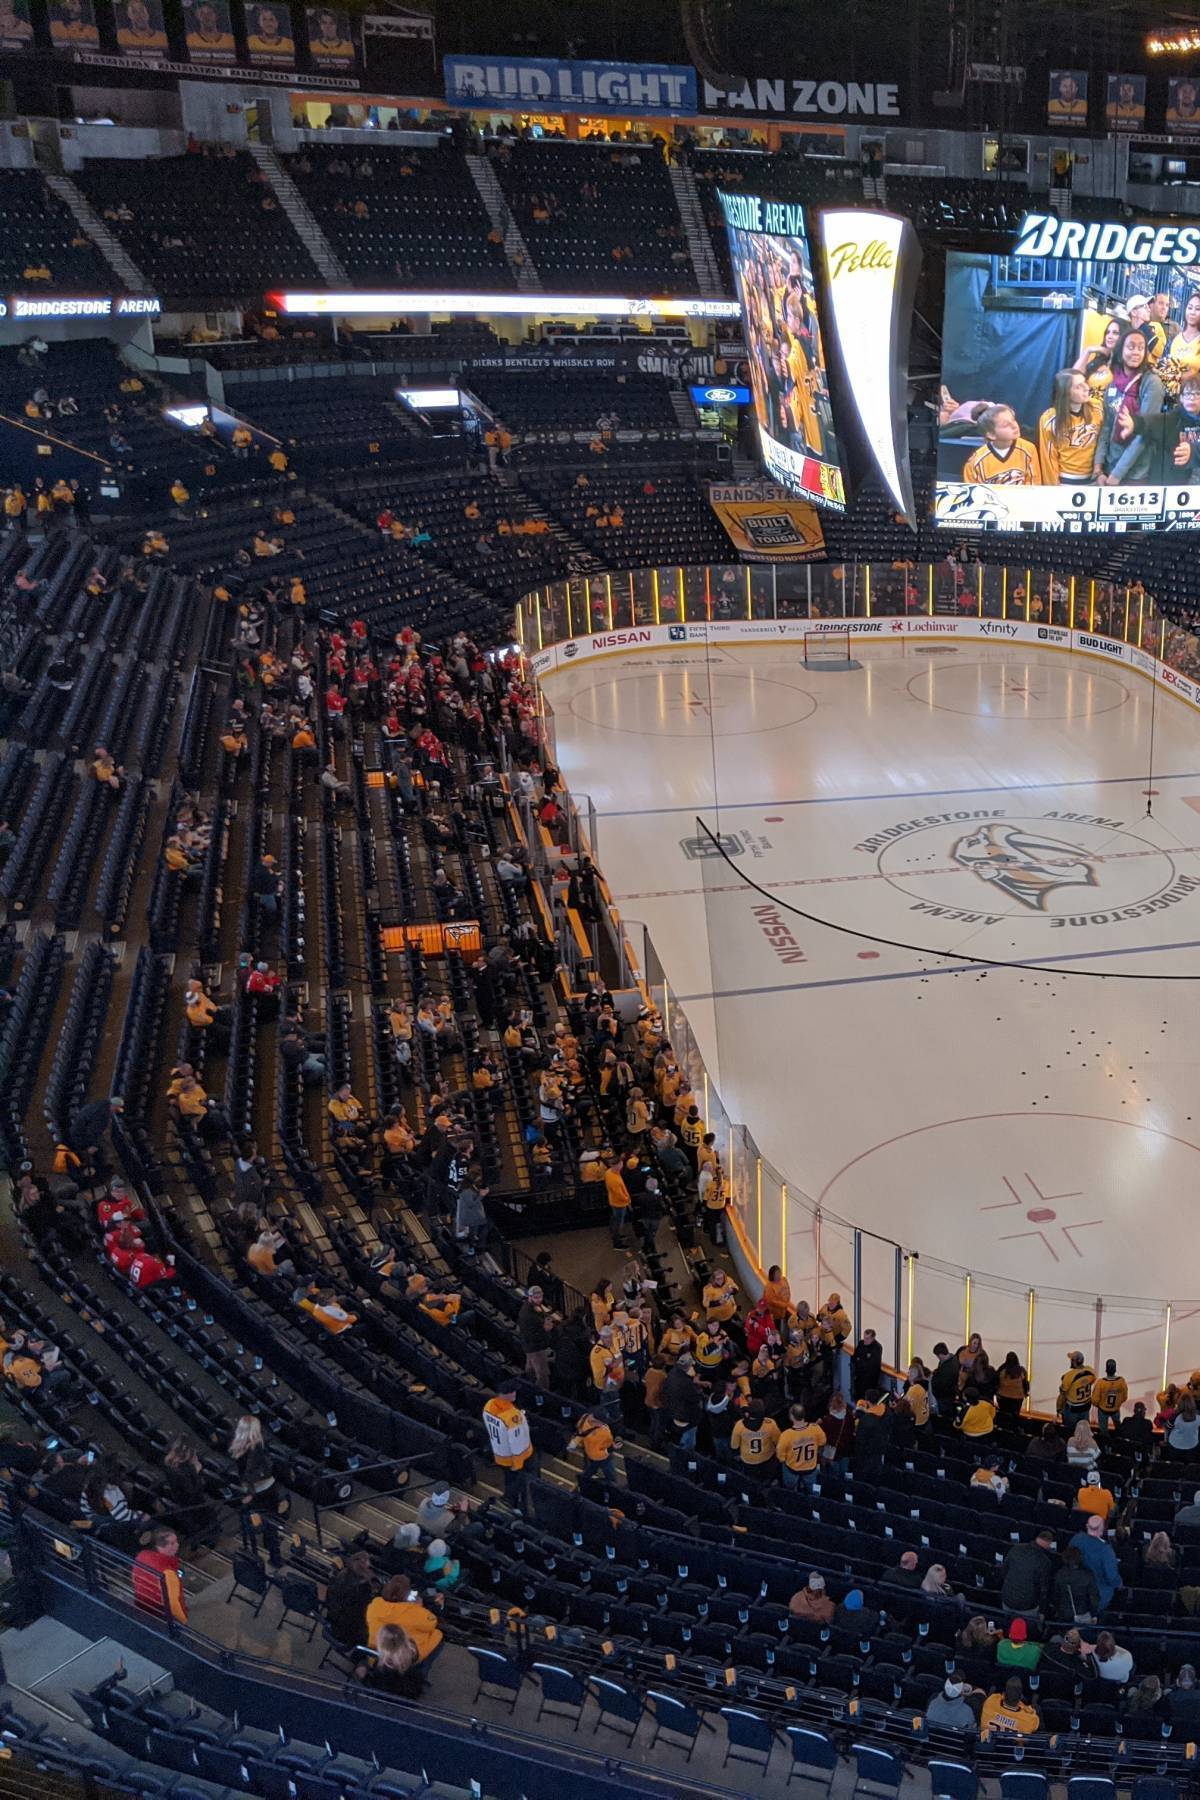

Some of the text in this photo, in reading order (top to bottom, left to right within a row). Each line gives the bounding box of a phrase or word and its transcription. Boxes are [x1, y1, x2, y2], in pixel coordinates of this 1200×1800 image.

[454, 65, 552, 101] BUD
[558, 69, 688, 109] LIGHT
[793, 81, 900, 116] ZONE
[765, 202, 805, 236] ARENA
[831, 239, 893, 279] Pella
[16, 300, 111, 316] BRIDGESTONE
[118, 300, 161, 313] ARENA
[473, 358, 615, 368] DIERKS BENTLEY'S WHISKEY ROW
[1071, 491, 1191, 508] 0 16:13 0
[748, 518, 788, 528] BUILT
[997, 521, 1024, 532] NHL
[1042, 521, 1064, 532] NYI
[1088, 522, 1109, 532] PHI
[1176, 522, 1187, 530] 1ST
[756, 534, 797, 544] TOUGH
[907, 621, 959, 632] Lochinvar
[979, 622, 1018, 637] xfinity
[592, 631, 651, 649] NISSAN
[1080, 636, 1123, 655] BUD LIGHT
[1162, 668, 1178, 687] DEX
[853, 809, 1125, 855] BRIDGESTONE ARENA
[908, 902, 1005, 925] ARENA
[750, 904, 809, 964] NISSAN
[1106, 1394, 1117, 1409] 9
[488, 1423, 502, 1445] 14
[750, 1438, 762, 1454] 9
[792, 1443, 815, 1463] 76
